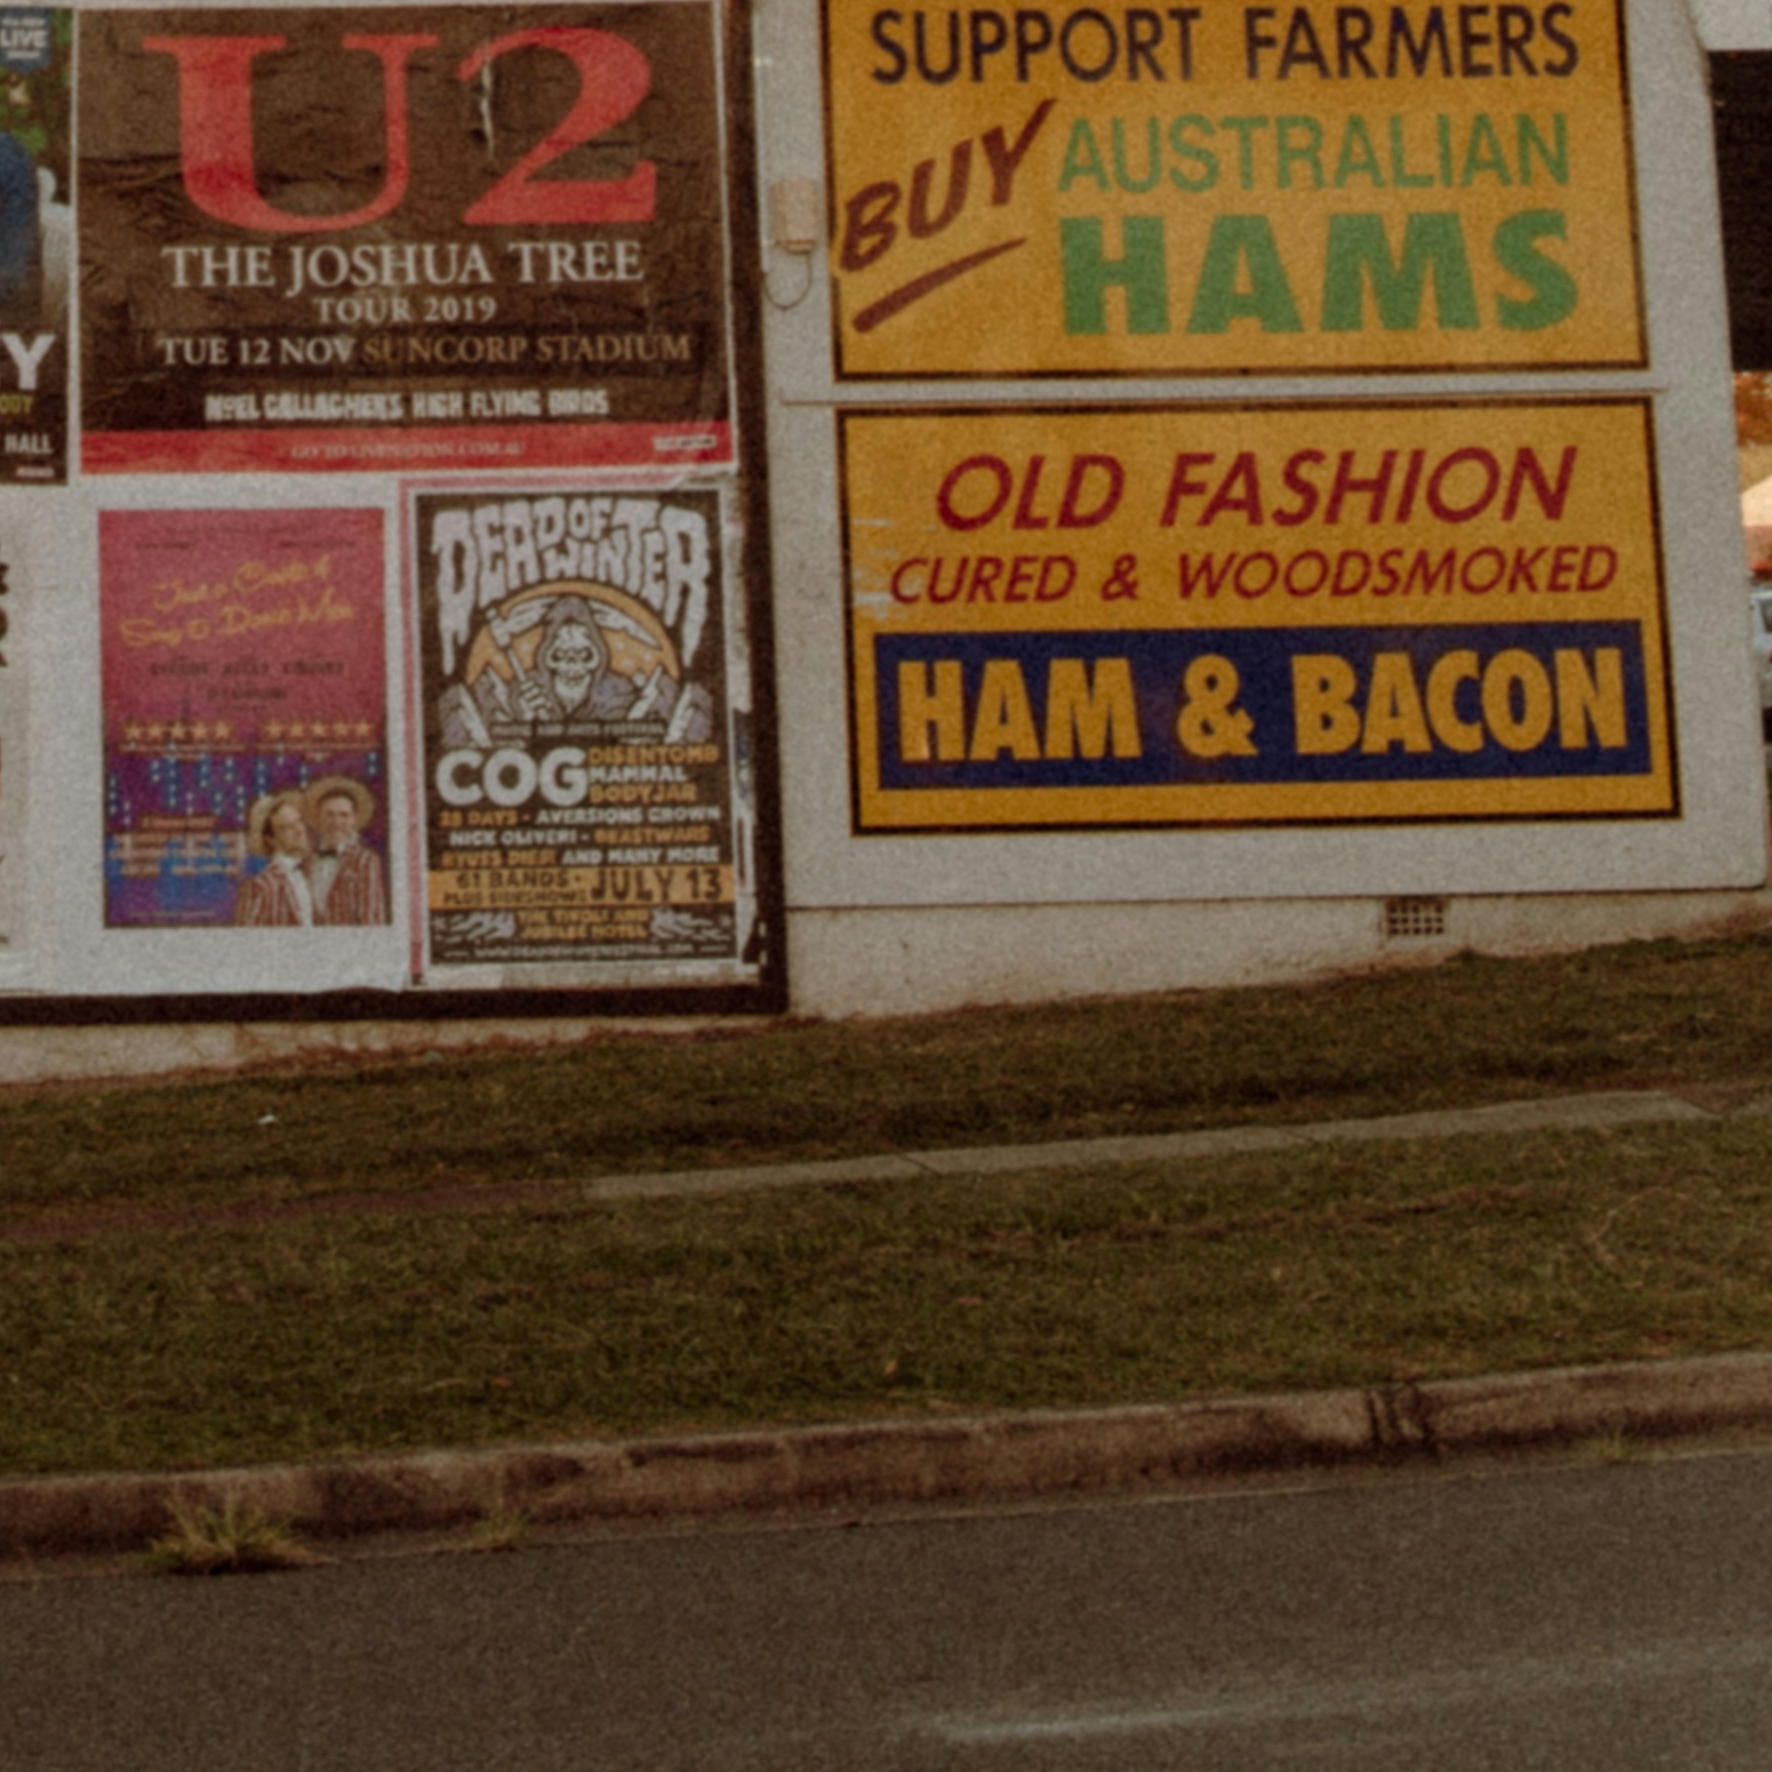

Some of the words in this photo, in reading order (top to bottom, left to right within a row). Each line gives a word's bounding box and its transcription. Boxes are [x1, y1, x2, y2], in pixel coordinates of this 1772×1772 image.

[0, 29, 47, 48] LIVE
[870, 6, 1203, 87] SUPPORT
[1243, 1, 1582, 81] FARMERS
[141, 26, 657, 234] U2
[1057, 110, 1573, 195] AUSTRALIAN
[839, 98, 1059, 273] BUY
[160, 243, 277, 290] THE
[284, 242, 497, 298] JOSHUA
[507, 239, 647, 284] TREE
[1057, 208, 1581, 337] HAMS
[313, 296, 414, 325] TOUR
[423, 294, 498, 323] 2019
[157, 337, 229, 367] TUE
[237, 338, 272, 366] 12
[278, 336, 359, 366] NOV
[361, 335, 529, 365] SUNCORP
[534, 332, 693, 362] STADIUM
[409, 392, 465, 418] HIGH
[469, 390, 543, 417] FLYING
[547, 389, 612, 416] BIRDS
[4, 434, 54, 455] HALL
[935, 453, 1126, 533] OLD
[1158, 444, 1580, 530] FASHION
[430, 497, 566, 677] DEAD
[568, 497, 615, 542] OF
[542, 498, 711, 669] WINTER
[889, 555, 1080, 607] CURED
[1099, 553, 1140, 603] &
[1175, 544, 1620, 601] WOODSMOKED
[896, 656, 1145, 765] HAM
[1174, 652, 1260, 761] &
[1292, 645, 1628, 757] BACON
[588, 745, 721, 766] DISENTOMB
[435, 746, 589, 807] COG
[589, 765, 688, 784] MAMMAL
[589, 783, 699, 805] BODYJAR
[466, 810, 519, 827] DAYS
[535, 808, 644, 826] AVERSIONS
[647, 805, 722, 824] CROWN
[448, 829, 497, 847] NICK
[500, 829, 578, 846] OLIVERI
[593, 826, 711, 844] BEASTWARS
[561, 849, 604, 866] AND
[607, 848, 663, 865] MANY
[666, 845, 721, 863] MORE
[489, 871, 570, 888] BANDS
[590, 869, 677, 902] JULY
[684, 868, 724, 900] 13
[612, 909, 651, 923] AND
